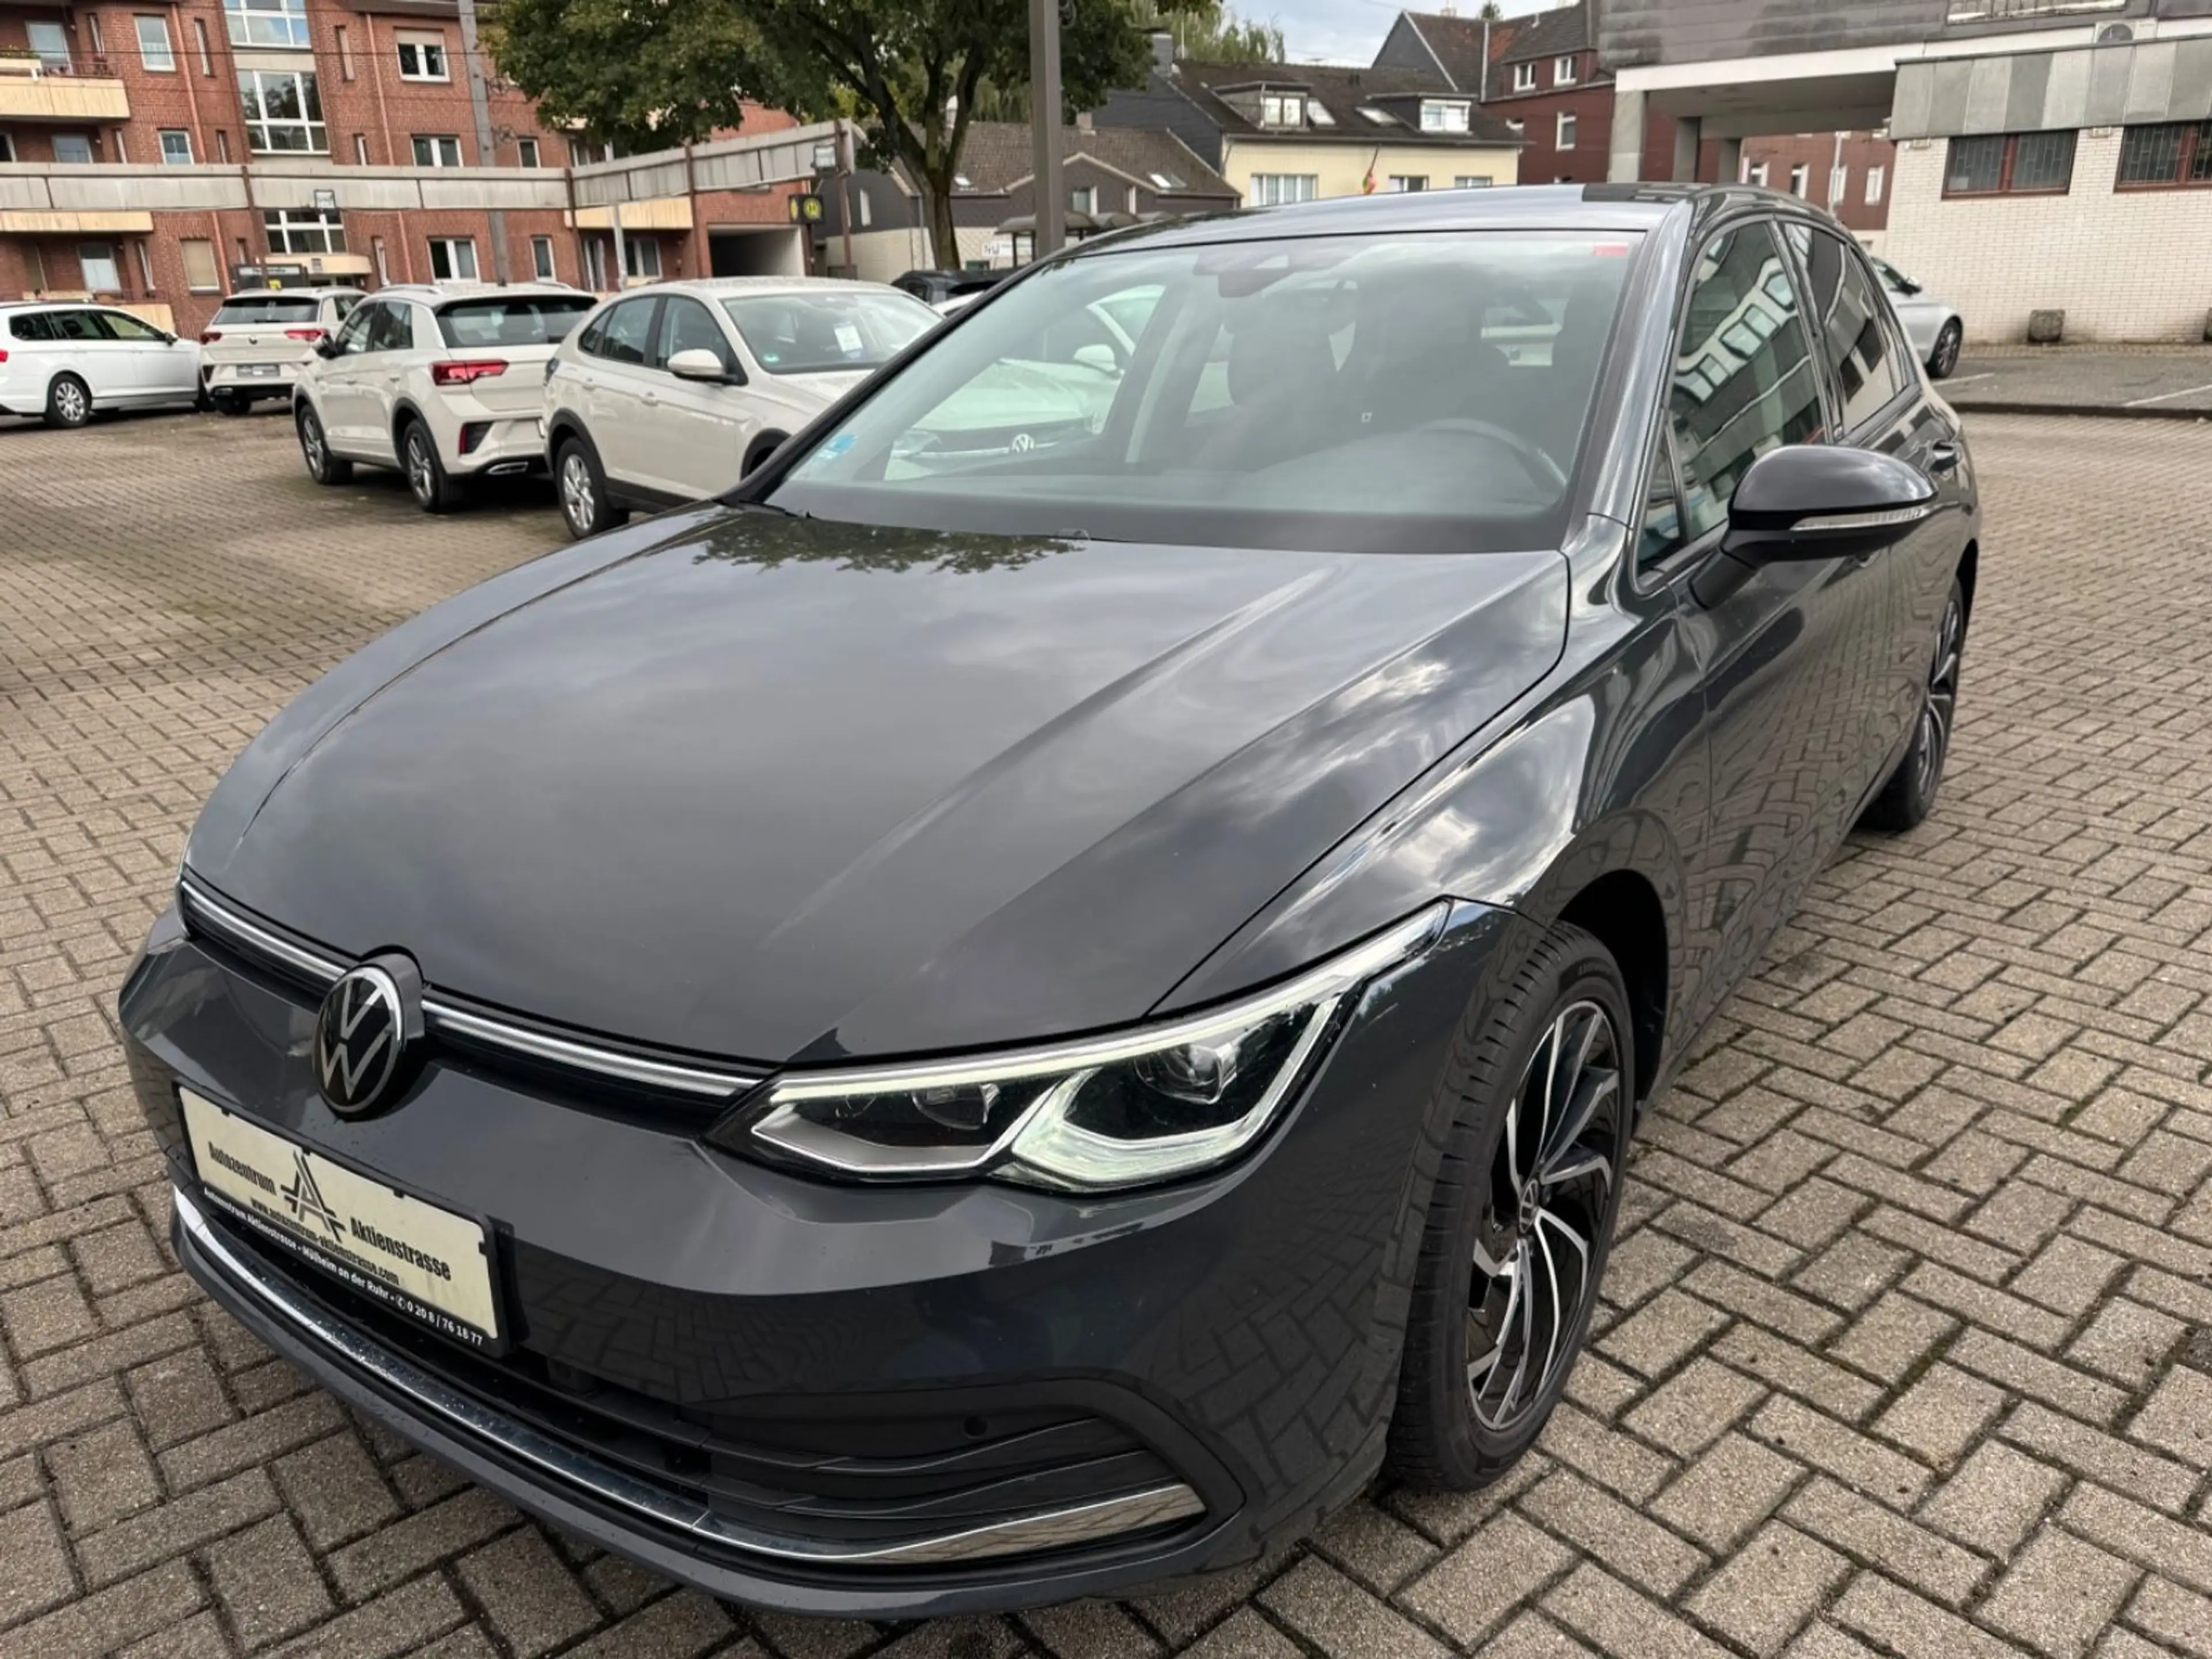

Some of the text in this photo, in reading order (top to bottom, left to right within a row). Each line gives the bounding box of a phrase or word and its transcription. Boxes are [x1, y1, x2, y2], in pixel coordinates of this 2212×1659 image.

[350, 1217, 451, 1281] Aktienstrasse
[351, 1272, 366, 1288] der
[407, 1301, 414, 1313] 0
[415, 1304, 427, 1319] 20
[441, 1317, 454, 1333] 76
[470, 1331, 483, 1347] 77
